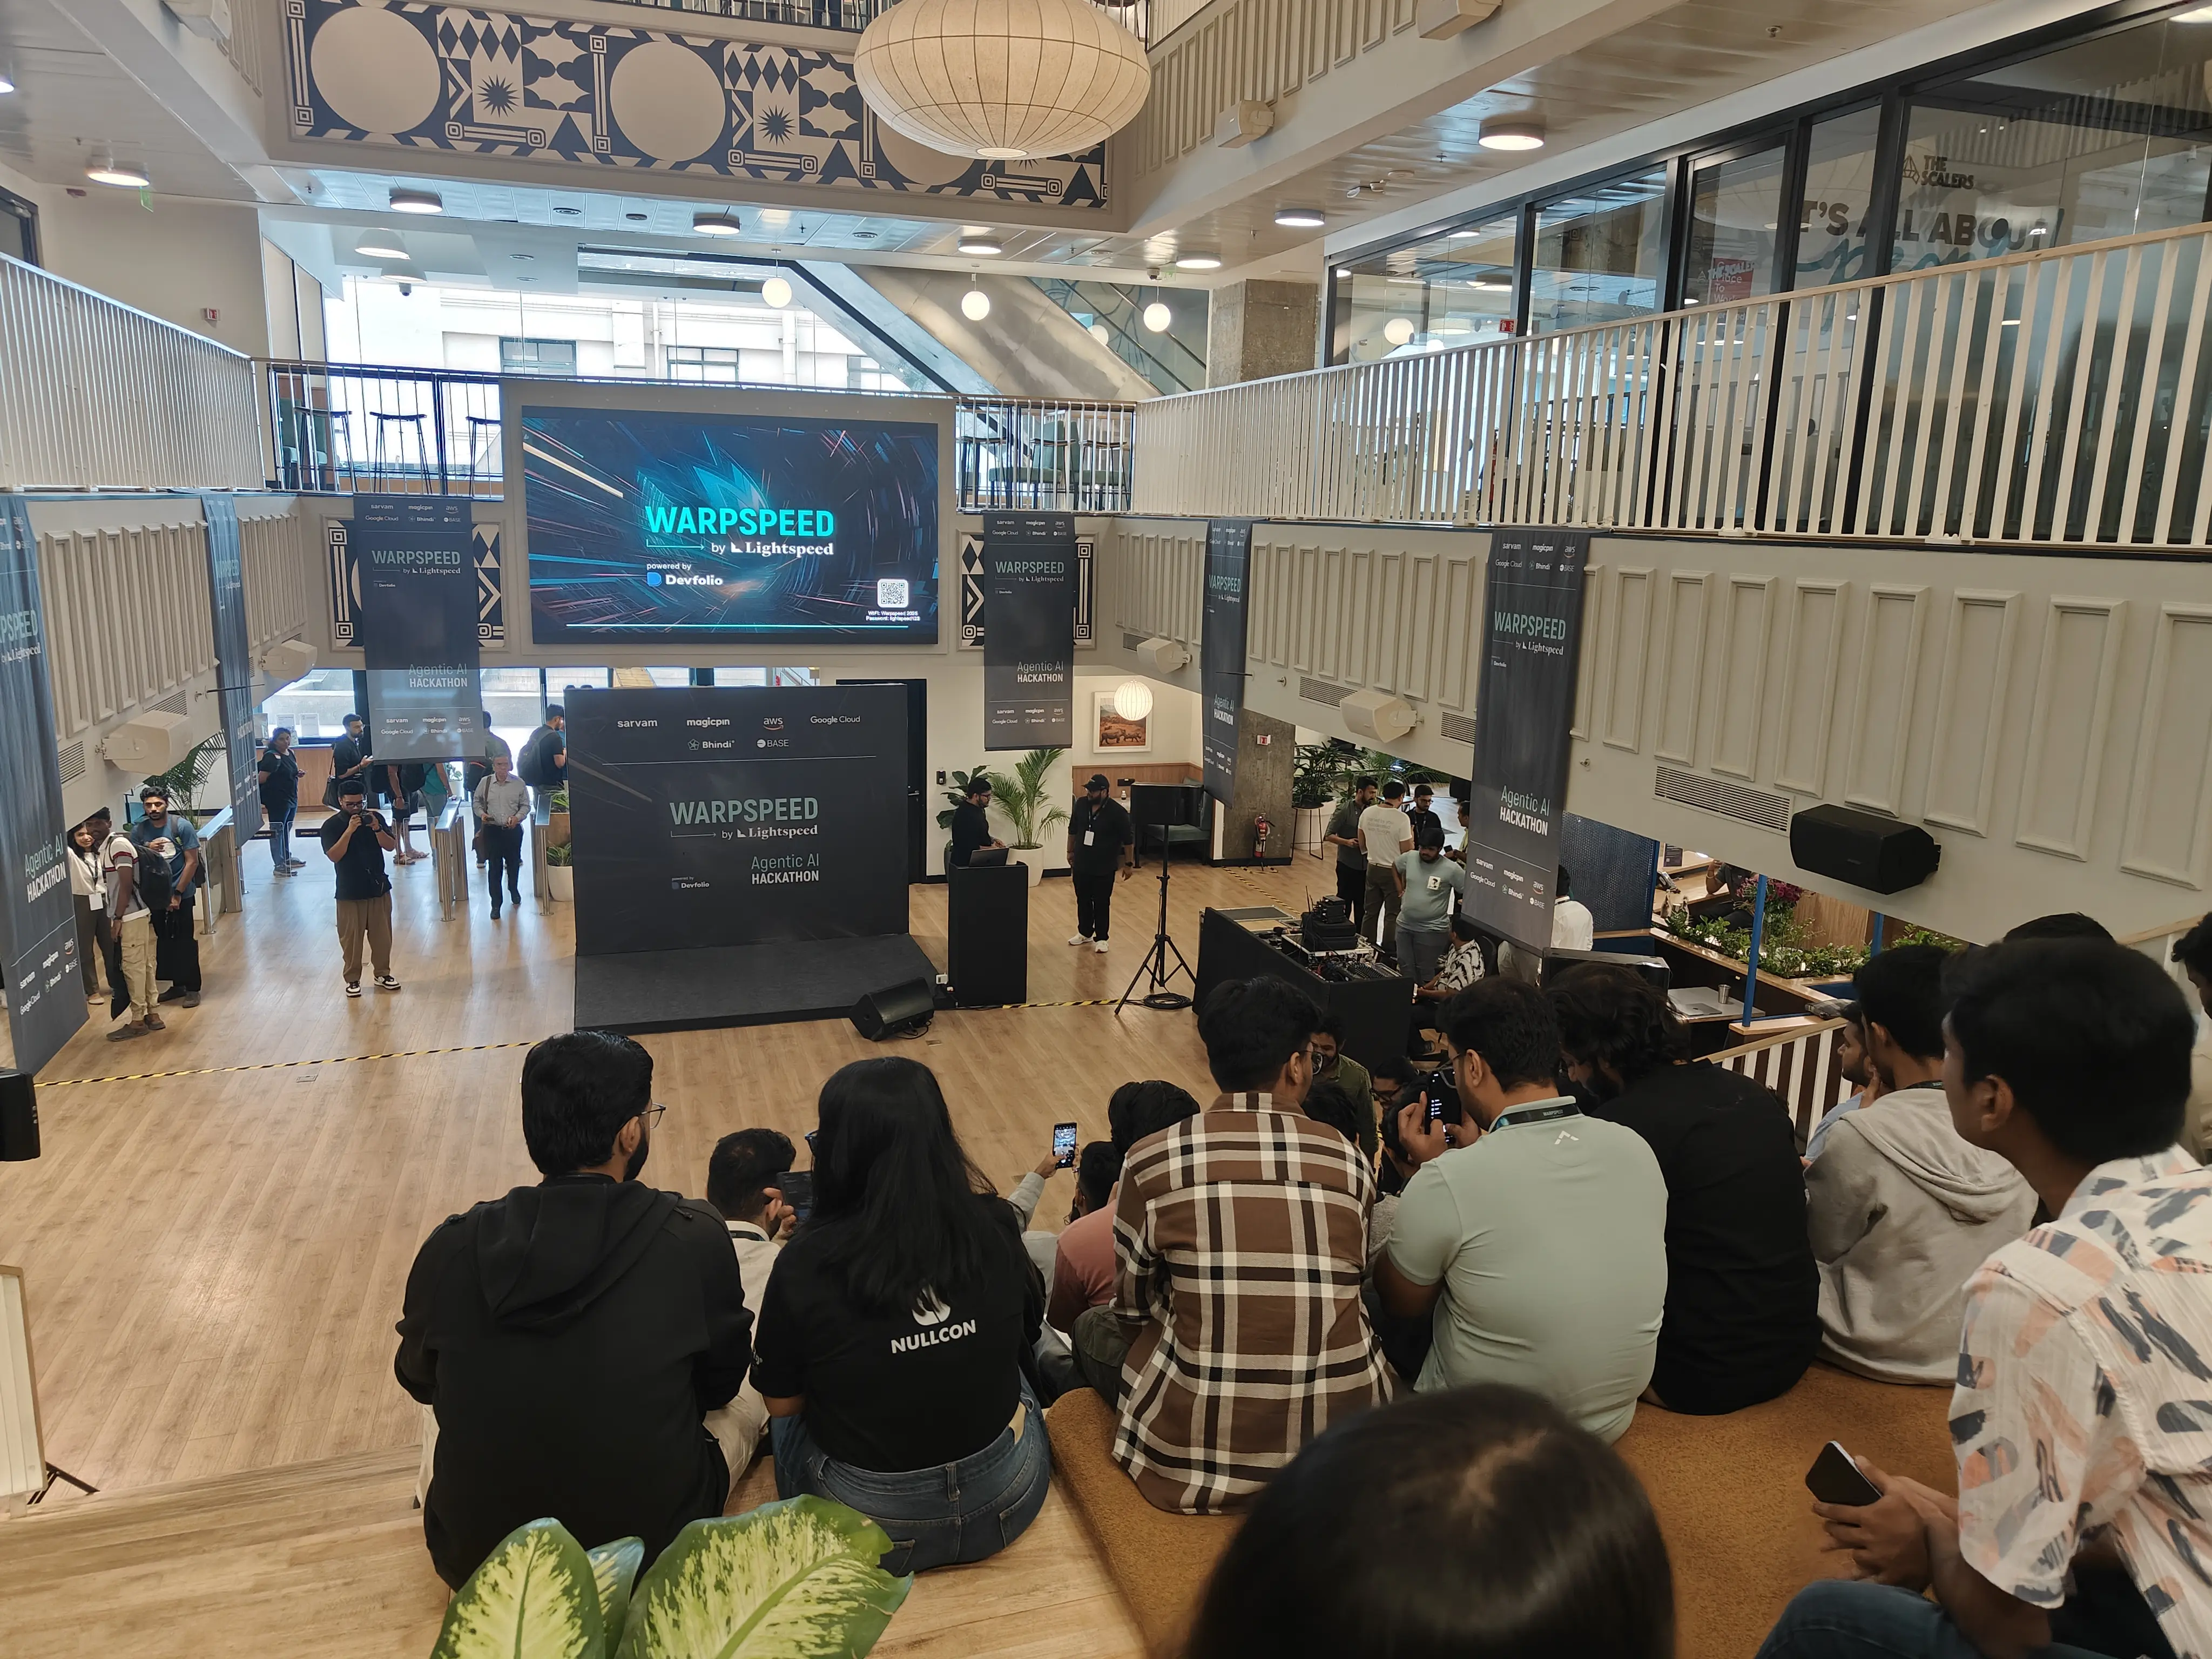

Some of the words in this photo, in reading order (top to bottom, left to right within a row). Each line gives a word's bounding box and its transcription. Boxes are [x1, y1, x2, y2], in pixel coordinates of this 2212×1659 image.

[1924, 155, 1947, 171] THE
[1921, 171, 1974, 190] SCALERS
[1800, 200, 1849, 237] T'S
[1715, 283, 1725, 292] To
[645, 506, 834, 537] WARPSPEED
[711, 542, 726, 555] by
[745, 542, 834, 557] Lightspeed
[1532, 544, 1553, 552] magicpin
[372, 550, 460, 564] WARPSPEED
[1495, 559, 1509, 568] Google
[682, 563, 691, 571] by
[995, 561, 1064, 573] WARPSPEED
[666, 574, 723, 585] Devfolio
[0, 610, 38, 644] PSPEED
[1495, 611, 1566, 640] WARPSPEED
[1515, 640, 1521, 650] by
[1528, 641, 1563, 656] Lightspeed
[409, 663, 453, 677] Agentic
[456, 663, 467, 675] AI
[1017, 661, 1053, 673] Agentic
[1055, 661, 1063, 671] AI
[409, 678, 468, 687] HACKATHON
[1017, 673, 1063, 683] HACKATHON
[1230, 699, 1235, 712] AI
[617, 719, 657, 727] sarvam
[686, 717, 730, 727] magicpin
[763, 717, 783, 725] aws
[810, 716, 838, 725] Google
[1213, 709, 1233, 726] HACKATHON
[767, 739, 789, 747] BASE
[1501, 785, 1538, 812] Agentic
[1540, 798, 1550, 817] AI
[670, 797, 818, 825] WARPSPEED
[1500, 806, 1548, 836] HACKATHON
[721, 830, 733, 840] by
[749, 825, 818, 840] Lightspeed
[25, 840, 53, 879] Agentic
[56, 833, 64, 858] AI
[751, 854, 803, 873] Agentic
[807, 853, 819, 867] AI
[1476, 858, 1494, 870] sarvam
[27, 861, 66, 903] HACKATHON
[752, 870, 819, 885] HACKATHON
[1470, 872, 1484, 884] Google
[1484, 878, 1495, 888] Cloud
[1503, 869, 1523, 882] magicpin
[1533, 881, 1543, 891] aws
[1534, 899, 1545, 909] BASE
[64, 938, 74, 950] aws
[69, 959, 78, 971] BASE
[20, 999, 31, 1015] Google
[891, 1319, 976, 1353] NULLCON
